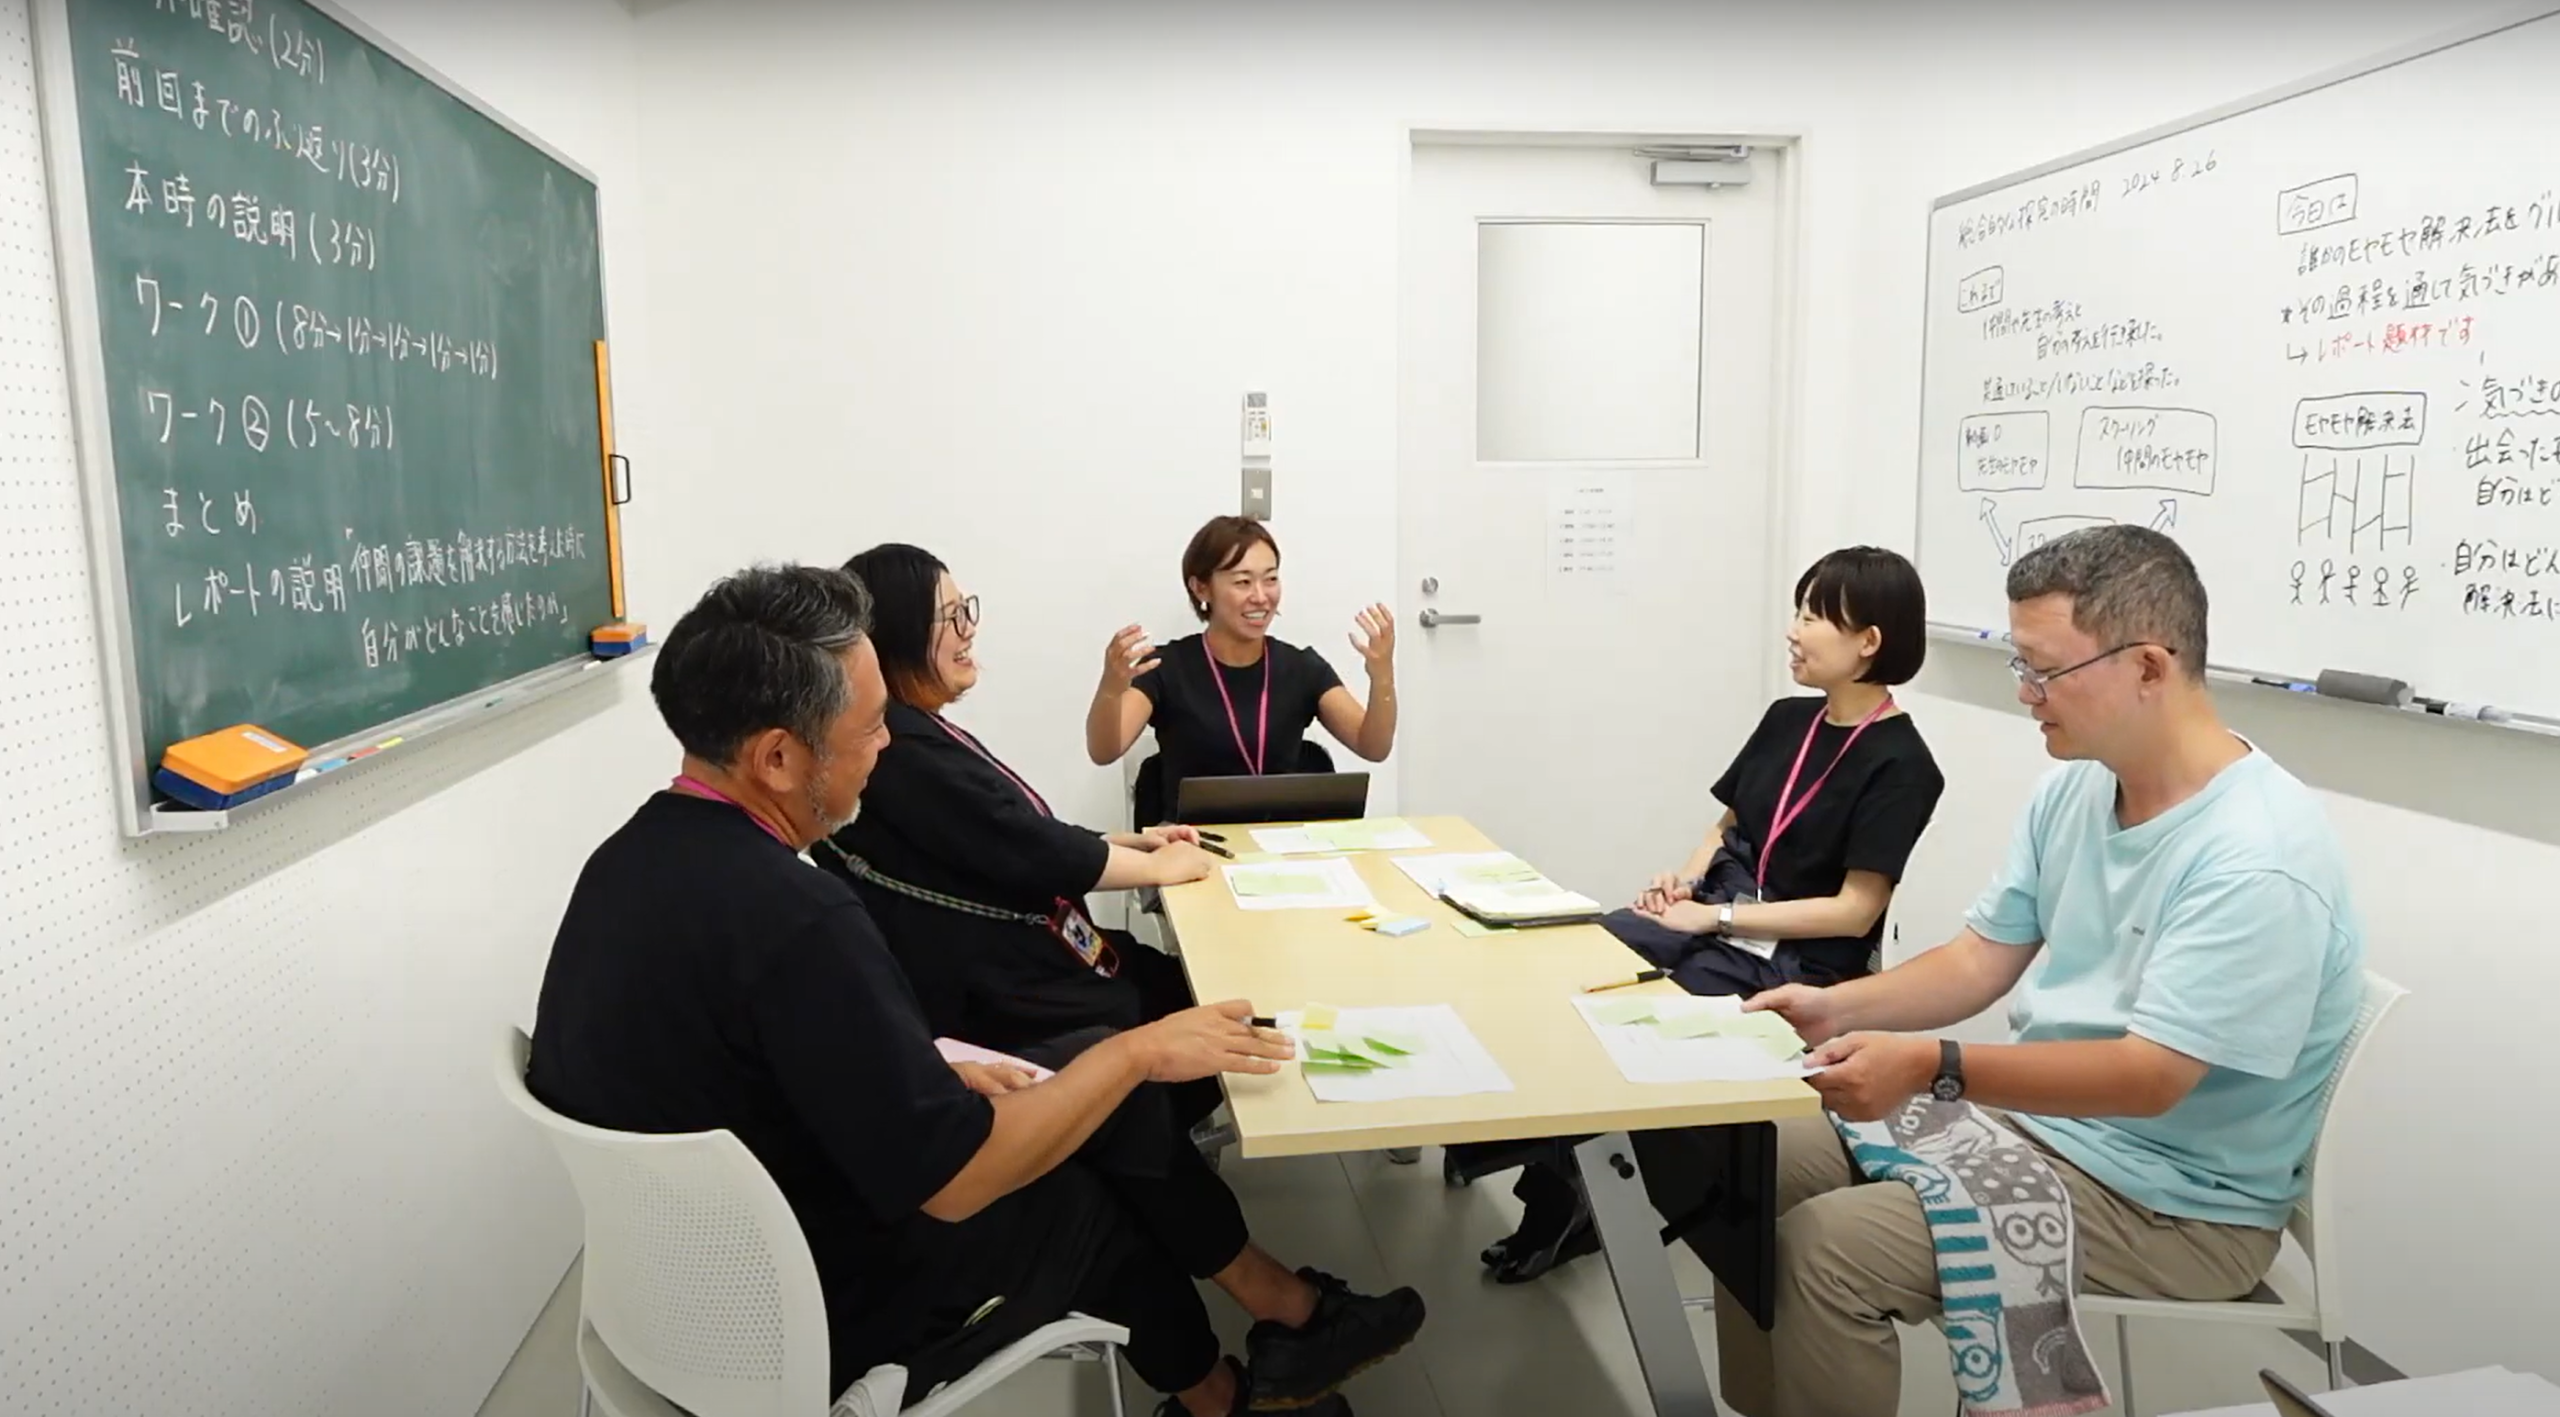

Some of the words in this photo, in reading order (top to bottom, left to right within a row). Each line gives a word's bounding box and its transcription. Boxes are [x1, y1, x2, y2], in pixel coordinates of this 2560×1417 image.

[124, 160, 375, 270] 本時の説明(3分)
[162, 487, 257, 537] まとめ
[174, 553, 347, 627] レポートの説明
